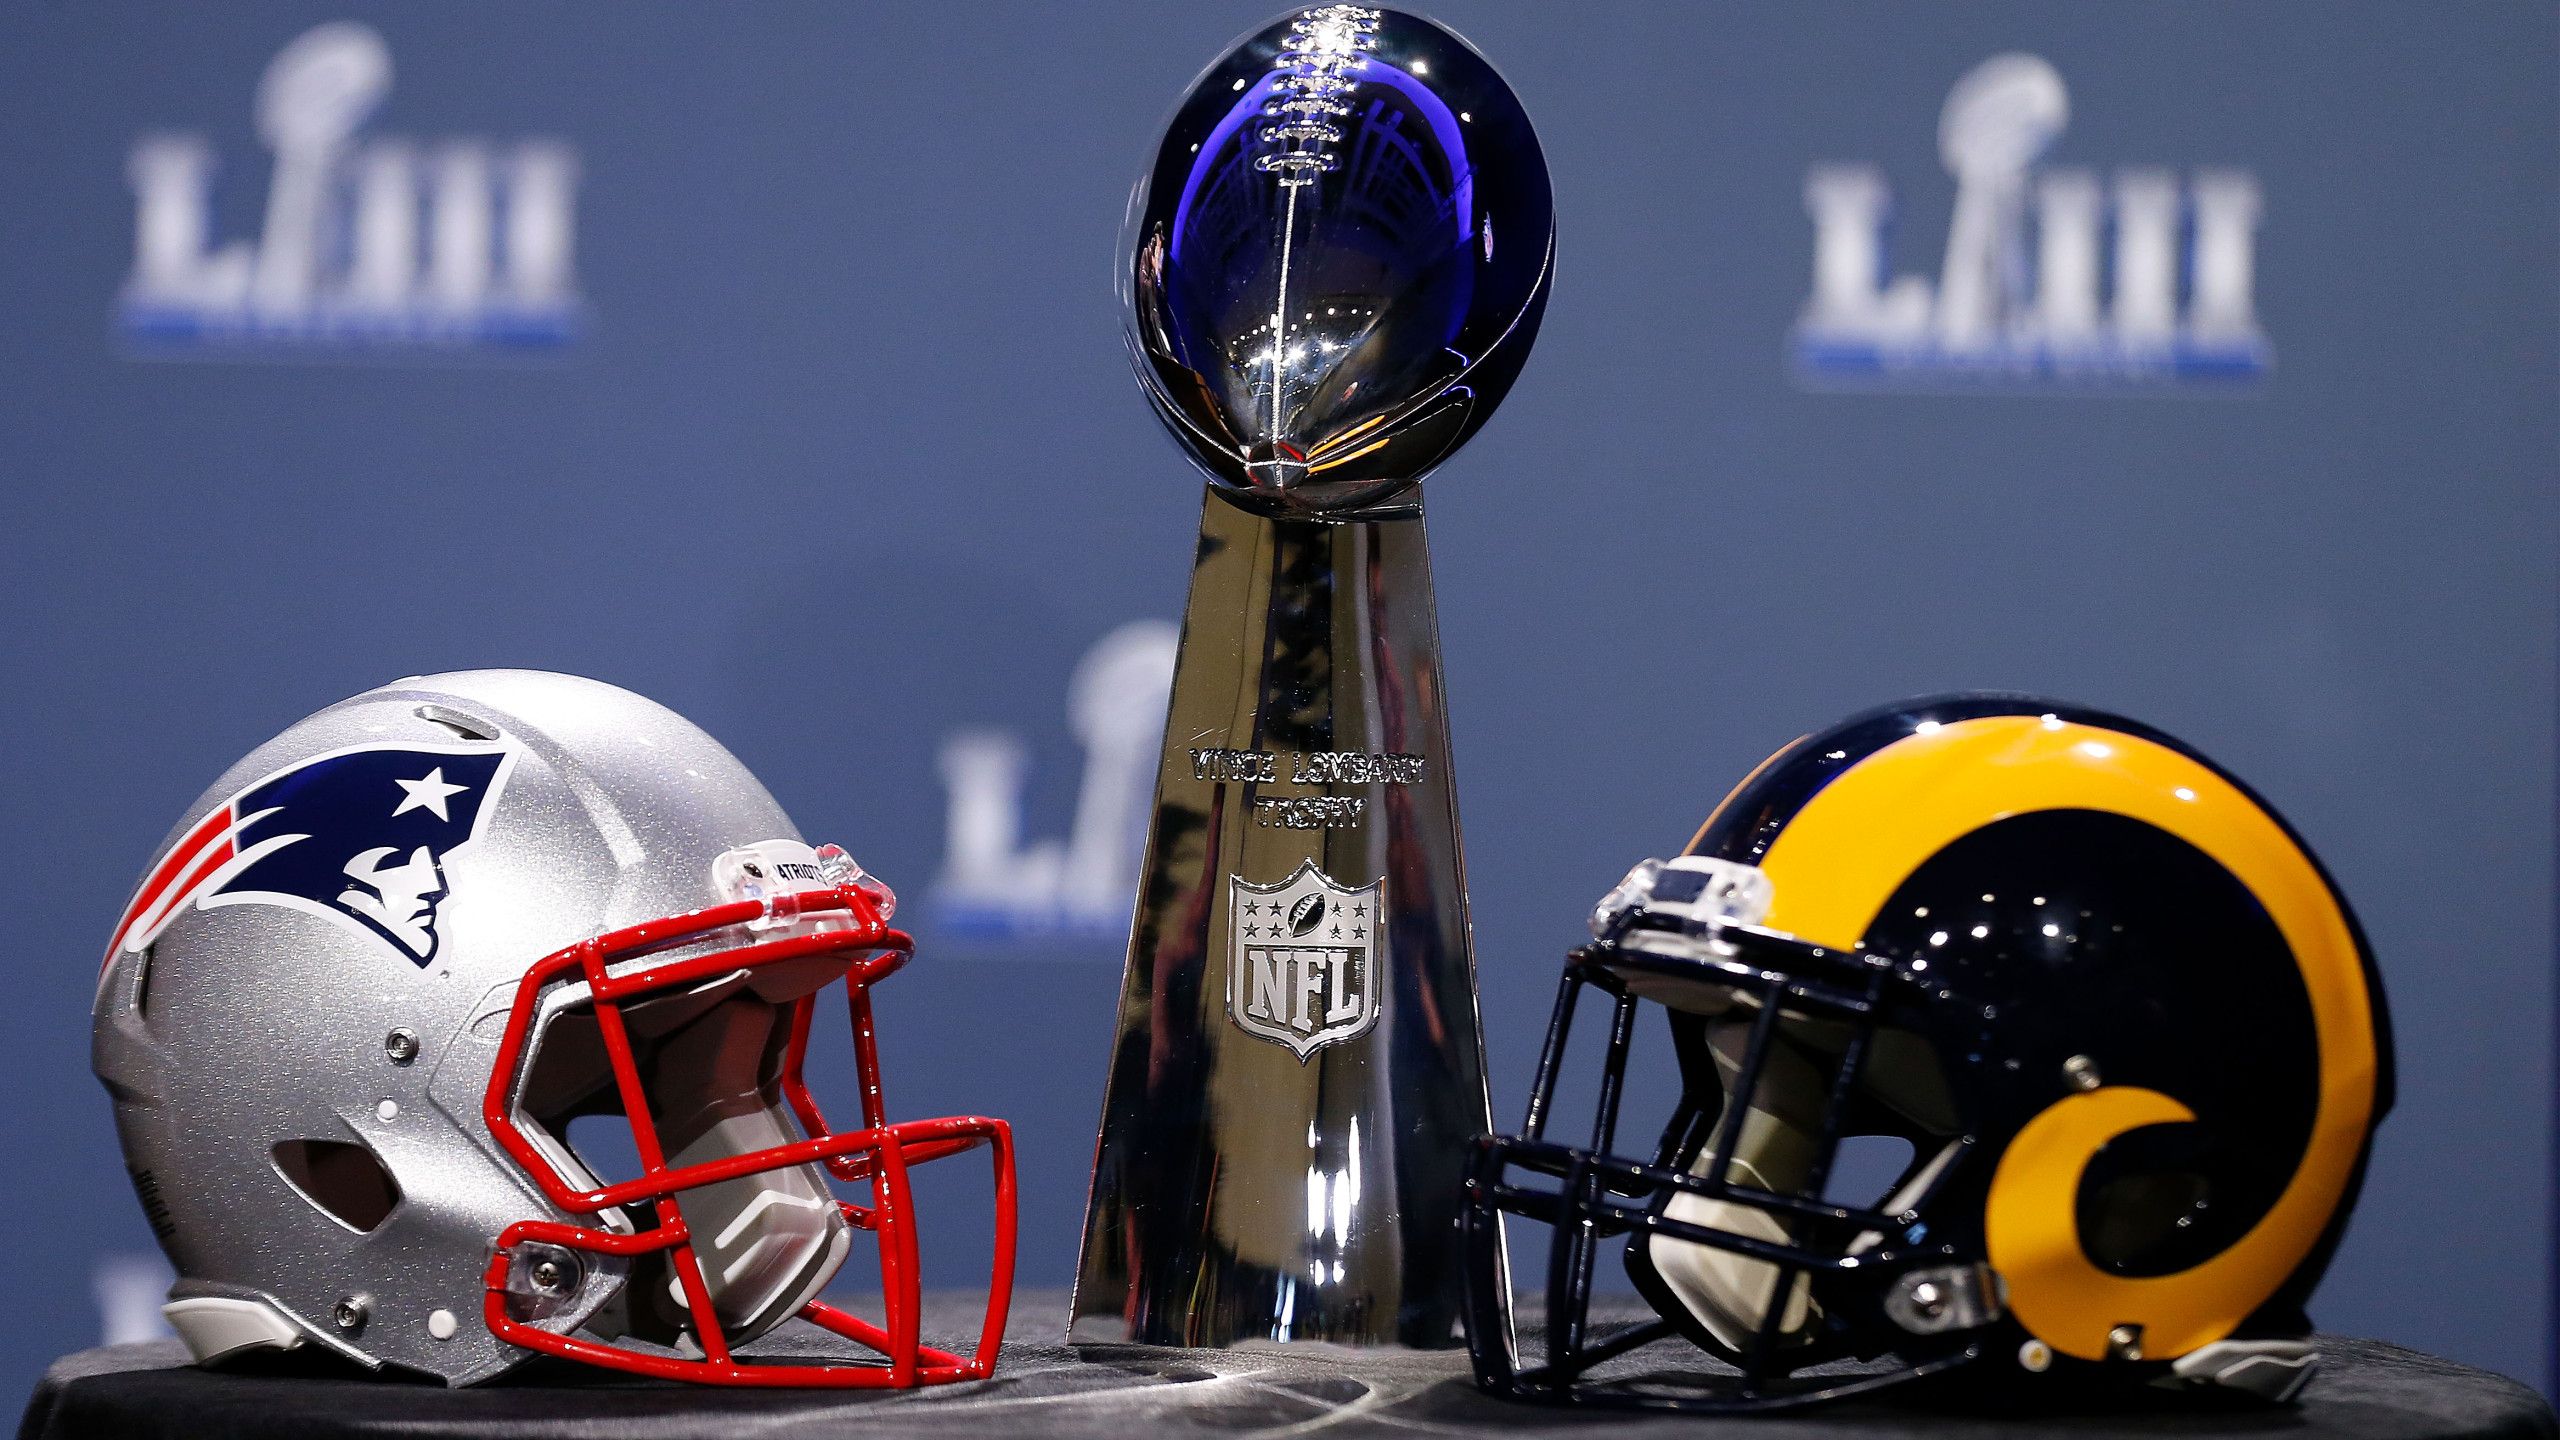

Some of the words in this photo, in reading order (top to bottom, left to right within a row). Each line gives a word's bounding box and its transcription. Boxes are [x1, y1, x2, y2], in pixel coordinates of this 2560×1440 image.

[1188, 748, 1276, 783] VINCE
[773, 863, 828, 887] ATRIOTS
[1248, 949, 1360, 1033] NFL
